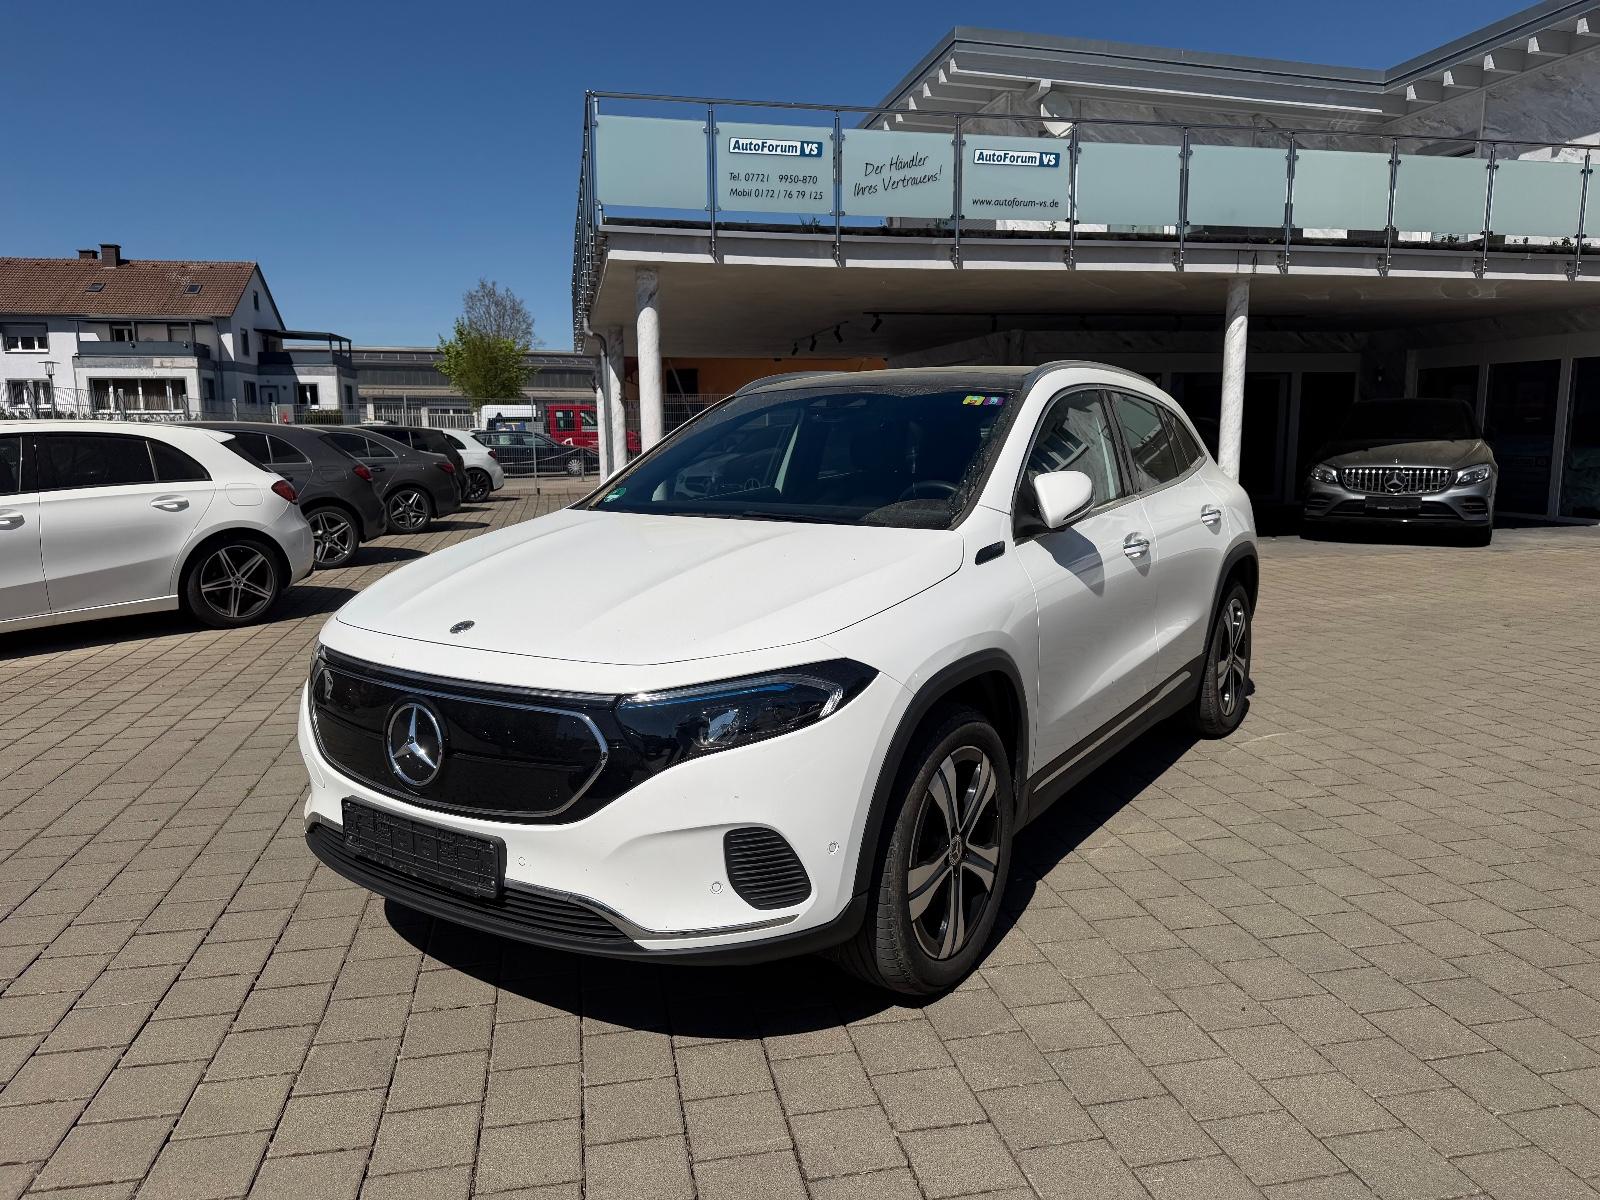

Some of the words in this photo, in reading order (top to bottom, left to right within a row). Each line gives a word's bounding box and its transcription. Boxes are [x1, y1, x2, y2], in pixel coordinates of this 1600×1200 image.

[732, 139, 798, 154] AutoForum
[803, 142, 819, 155] VS
[864, 162, 886, 177] Der
[889, 151, 929, 172] Händler
[976, 151, 1037, 165] AutoForum
[1042, 153, 1056, 166] VS
[729, 172, 742, 182] Tel.
[744, 172, 770, 183] 07721
[778, 174, 818, 185] 9950-870
[853, 181, 878, 197] Ihres
[882, 164, 943, 191] Vertrauens!
[729, 188, 753, 198] Mobil
[754, 188, 775, 198] 0172
[783, 189, 793, 199] 76
[796, 190, 806, 199] 79
[809, 191, 823, 200] 125
[972, 197, 1059, 209] www.autoforum-vs.de
